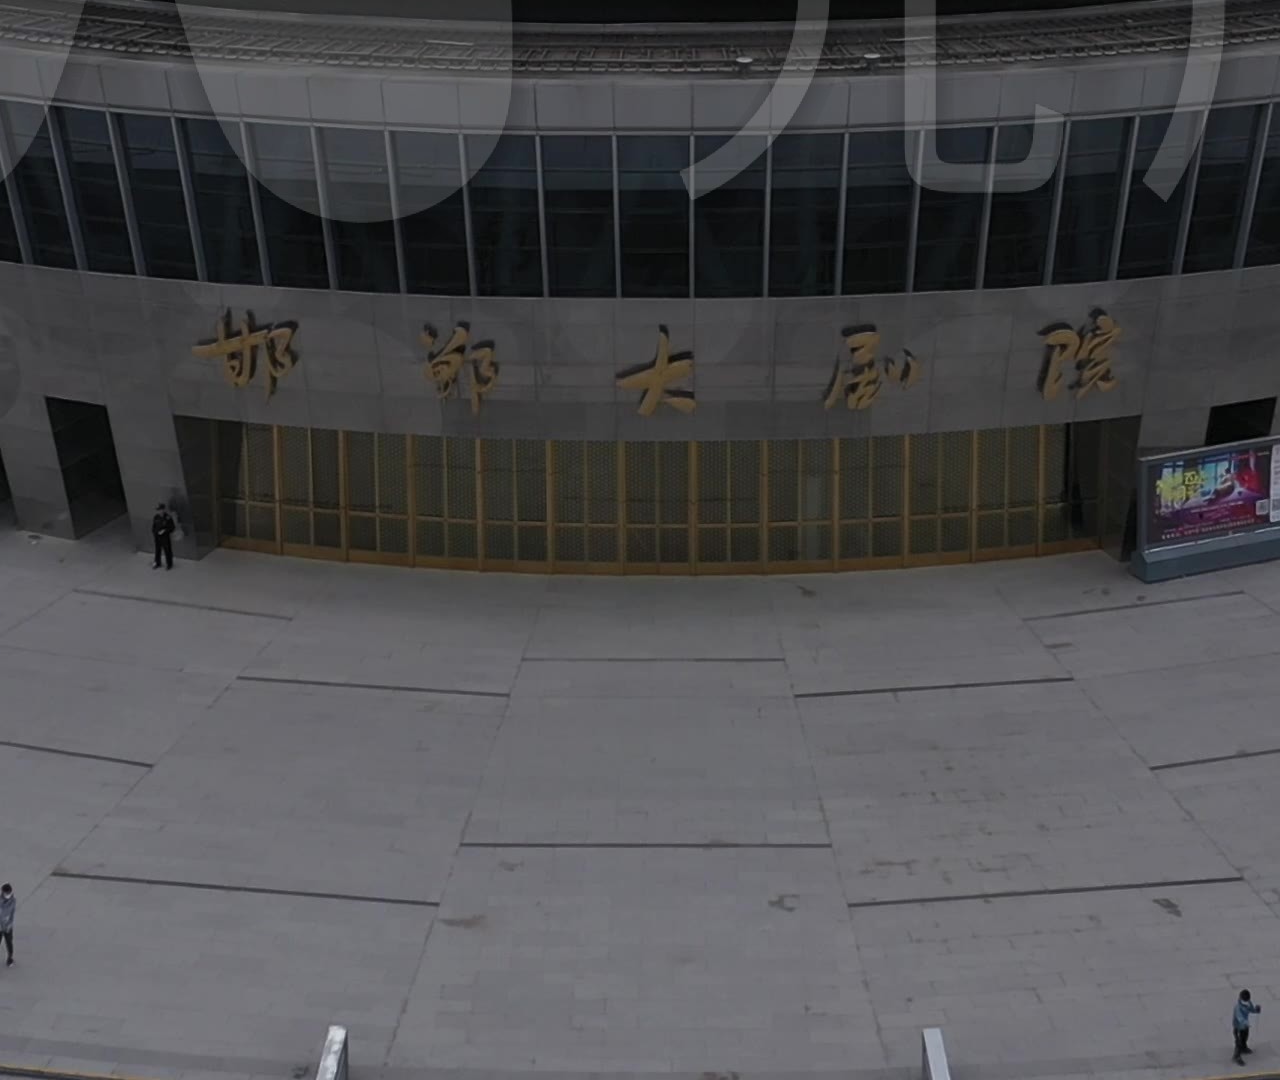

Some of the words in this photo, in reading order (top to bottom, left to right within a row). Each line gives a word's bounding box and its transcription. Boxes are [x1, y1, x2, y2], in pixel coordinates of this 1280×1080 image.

[191, 308, 1121, 415] 邯郸大剧院
